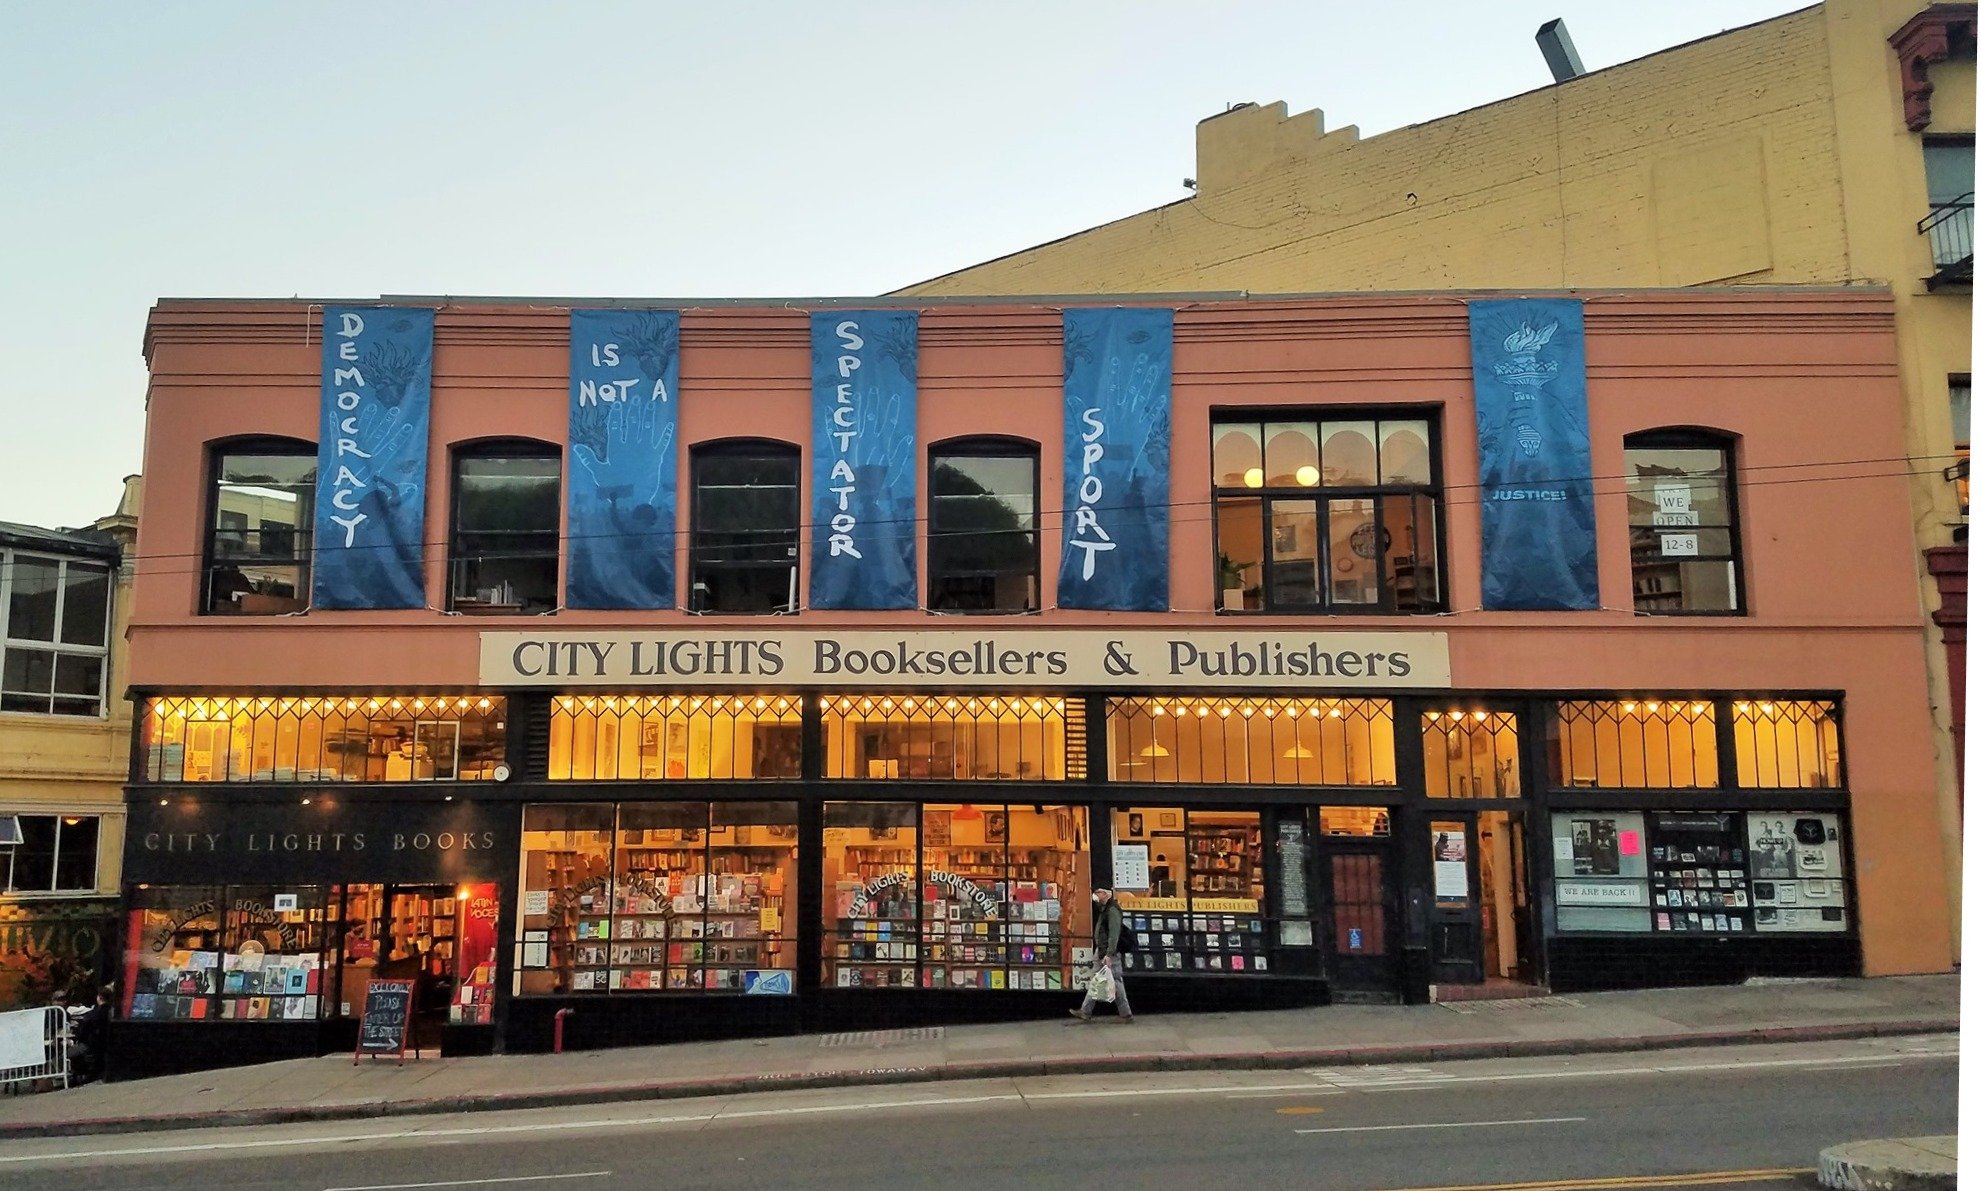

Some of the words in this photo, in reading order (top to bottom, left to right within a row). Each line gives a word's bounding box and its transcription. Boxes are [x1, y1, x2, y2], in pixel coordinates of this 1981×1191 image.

[591, 343, 620, 367] IS
[578, 377, 641, 408] NOT
[651, 378, 668, 402] A
[331, 312, 371, 548] DEMOCRACY
[828, 320, 864, 560] SPECTATOR
[1069, 407, 1117, 581] SPORT
[1492, 489, 1567, 501] JUSTICE!
[1663, 497, 1684, 508] WE
[1656, 515, 1693, 526] OPEN
[1665, 539, 1694, 550] 12-8
[512, 640, 617, 677] CITY
[629, 640, 785, 677] LIGHTS
[813, 639, 1068, 677] Booksellers
[1103, 640, 1140, 677] &
[1168, 640, 1411, 678] Publishers
[144, 833, 221, 851] CITY
[249, 833, 366, 851] LIGHTS
[393, 832, 495, 850] BOOKS
[847, 890, 869, 919] CITY
[866, 871, 910, 896] LIGHTS
[930, 870, 999, 919] BOOKSTORE
[1564, 888, 1579, 896] WE
[1581, 888, 1599, 896] ARE
[1602, 888, 1627, 897] BACK
[1147, 901, 1187, 910] LIGHTS
[234, 899, 297, 949] BOOKSTORE
